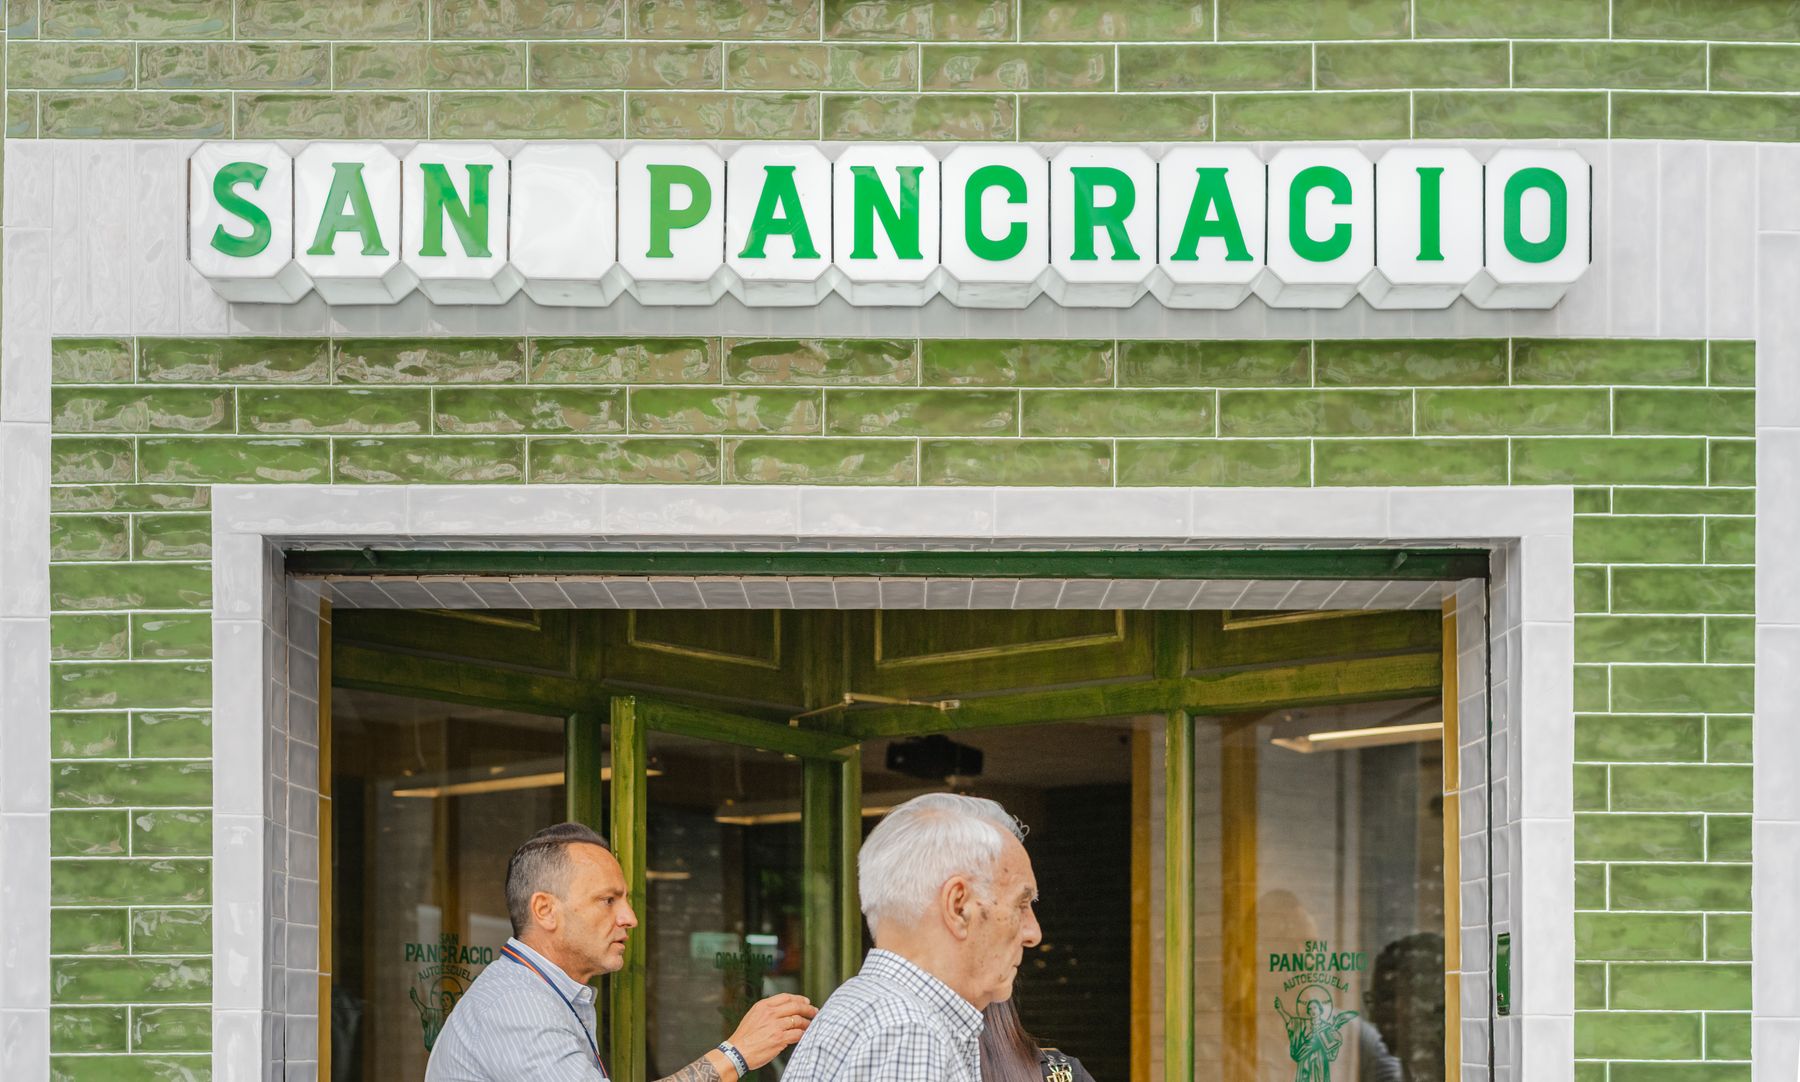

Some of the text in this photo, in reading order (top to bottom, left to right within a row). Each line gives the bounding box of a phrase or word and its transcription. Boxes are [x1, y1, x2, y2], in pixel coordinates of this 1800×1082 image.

[211, 162, 1568, 264] SAN PANCRACIO
[439, 933, 459, 945] SAN
[1305, 940, 1328, 952] SAN
[405, 943, 493, 965] PANCRACIO
[1269, 952, 1369, 972] PANCRACIO
[1283, 973, 1349, 992] AUTOESCUELA
